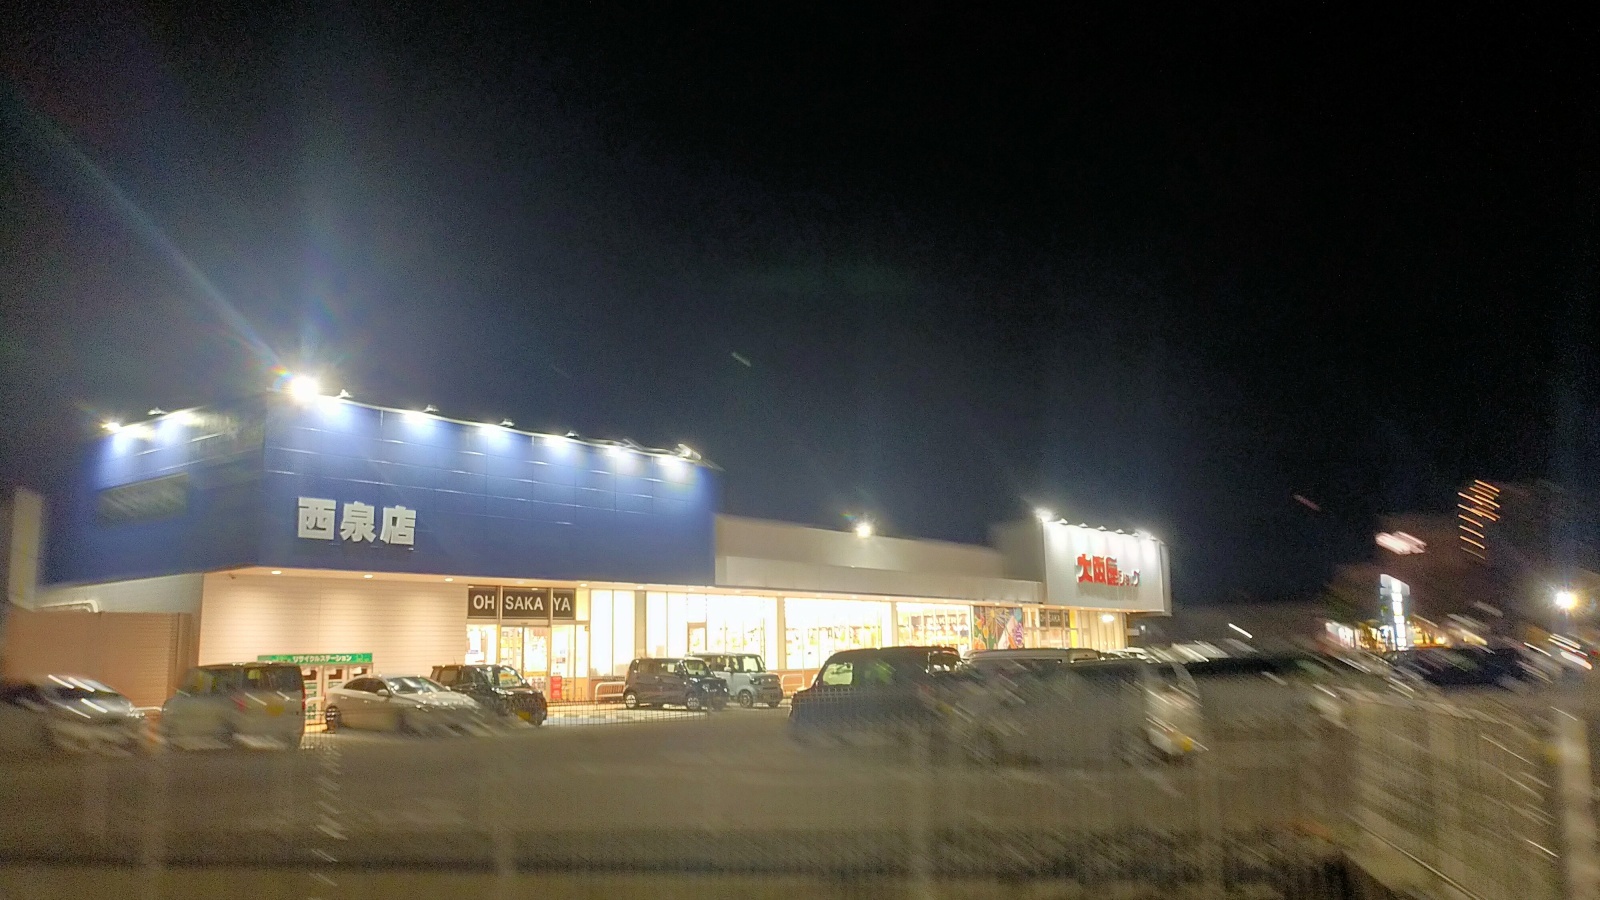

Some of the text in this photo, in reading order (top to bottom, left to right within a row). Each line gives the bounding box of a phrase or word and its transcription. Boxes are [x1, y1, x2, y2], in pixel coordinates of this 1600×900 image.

[298, 496, 416, 545] 西泉店
[473, 594, 571, 611] OH SAKA YA
